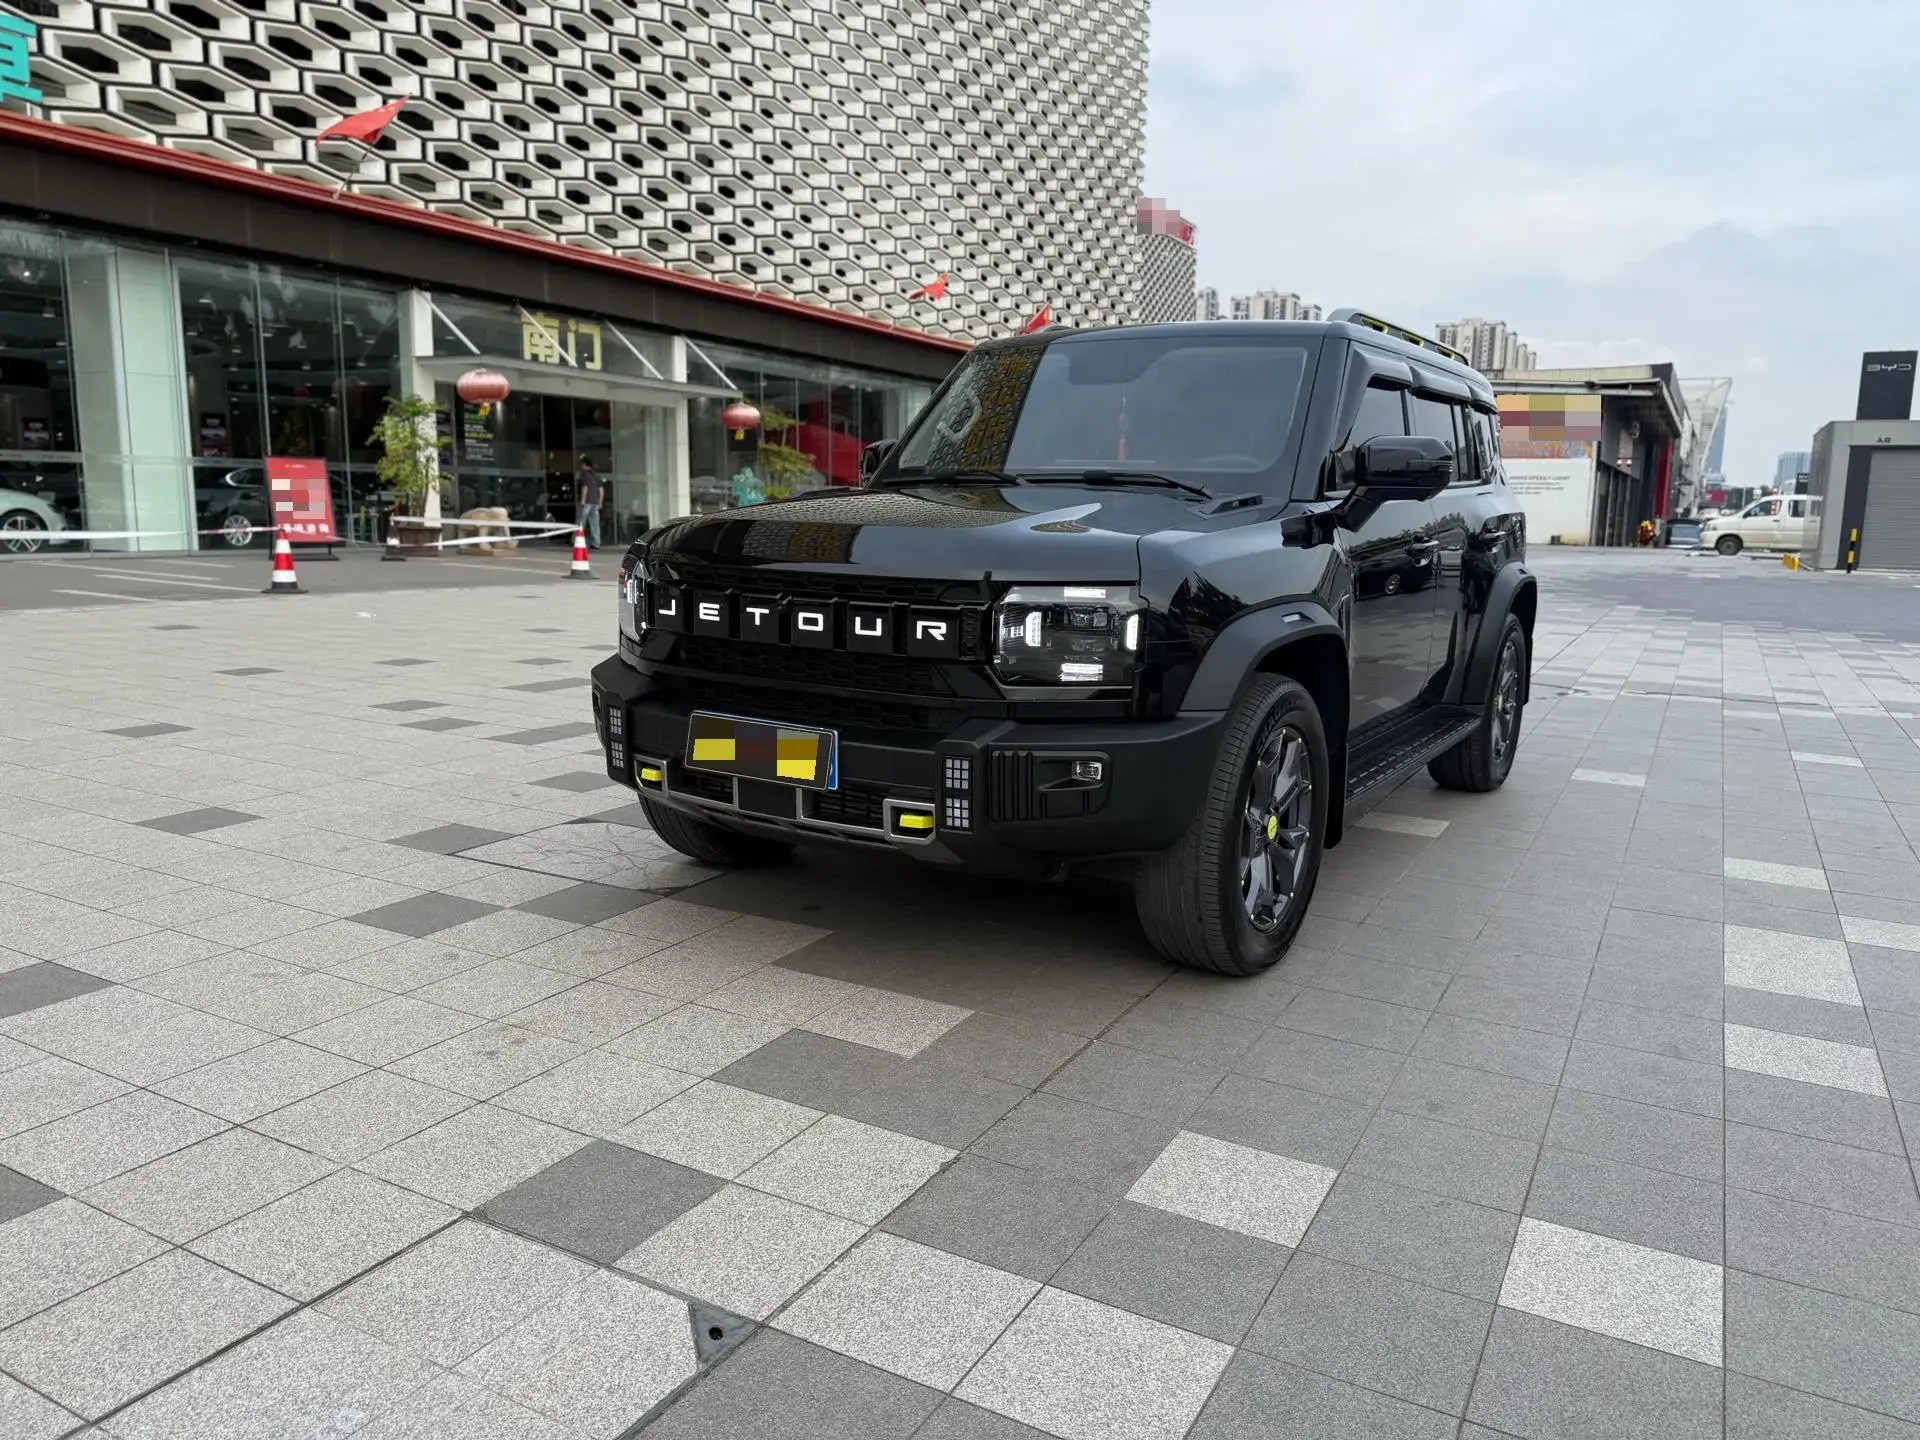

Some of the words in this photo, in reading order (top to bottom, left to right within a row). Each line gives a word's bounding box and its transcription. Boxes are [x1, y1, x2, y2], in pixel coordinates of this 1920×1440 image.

[520, 311, 603, 371] 南门
[1866, 362, 1913, 372] BYD
[1875, 436, 1892, 444] 入口
[658, 598, 948, 641] JETOUR
